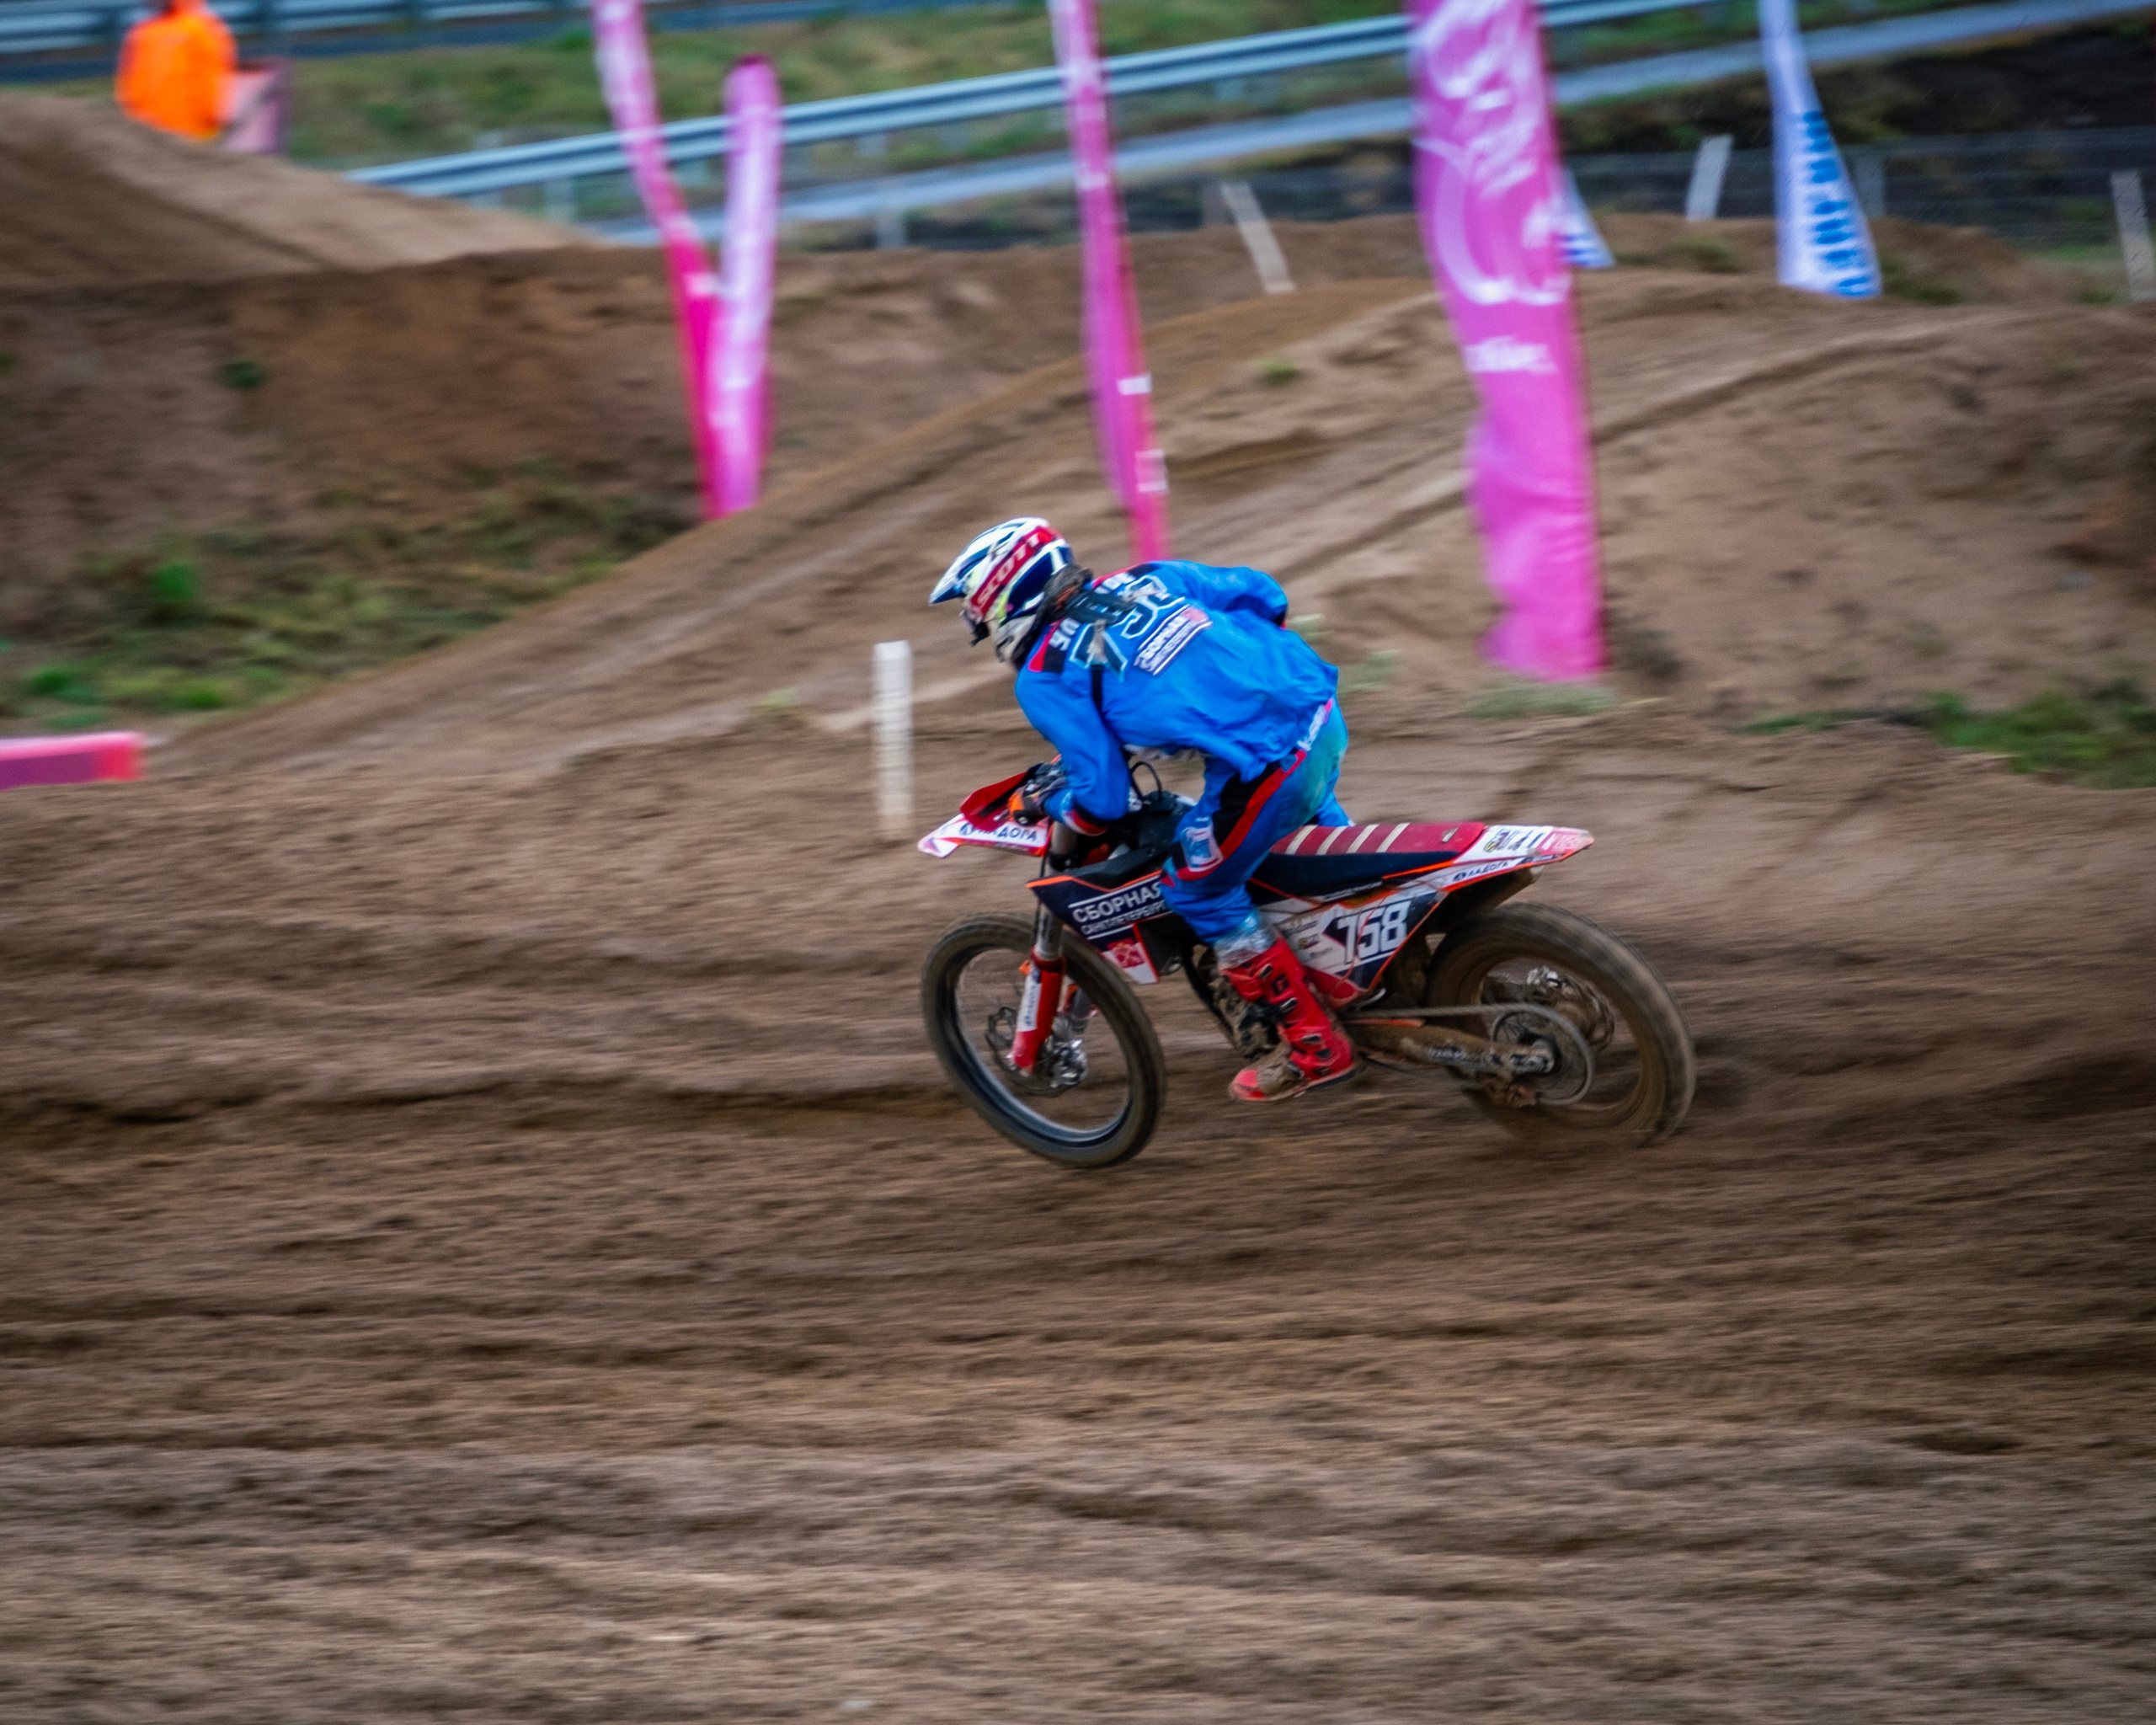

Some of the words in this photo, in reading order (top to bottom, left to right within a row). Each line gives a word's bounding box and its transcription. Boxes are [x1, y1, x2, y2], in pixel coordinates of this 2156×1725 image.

[976, 531, 1040, 608] SCOTT
[1071, 881, 1161, 923] СБОРНАЯ
[1337, 900, 1413, 965] 758
